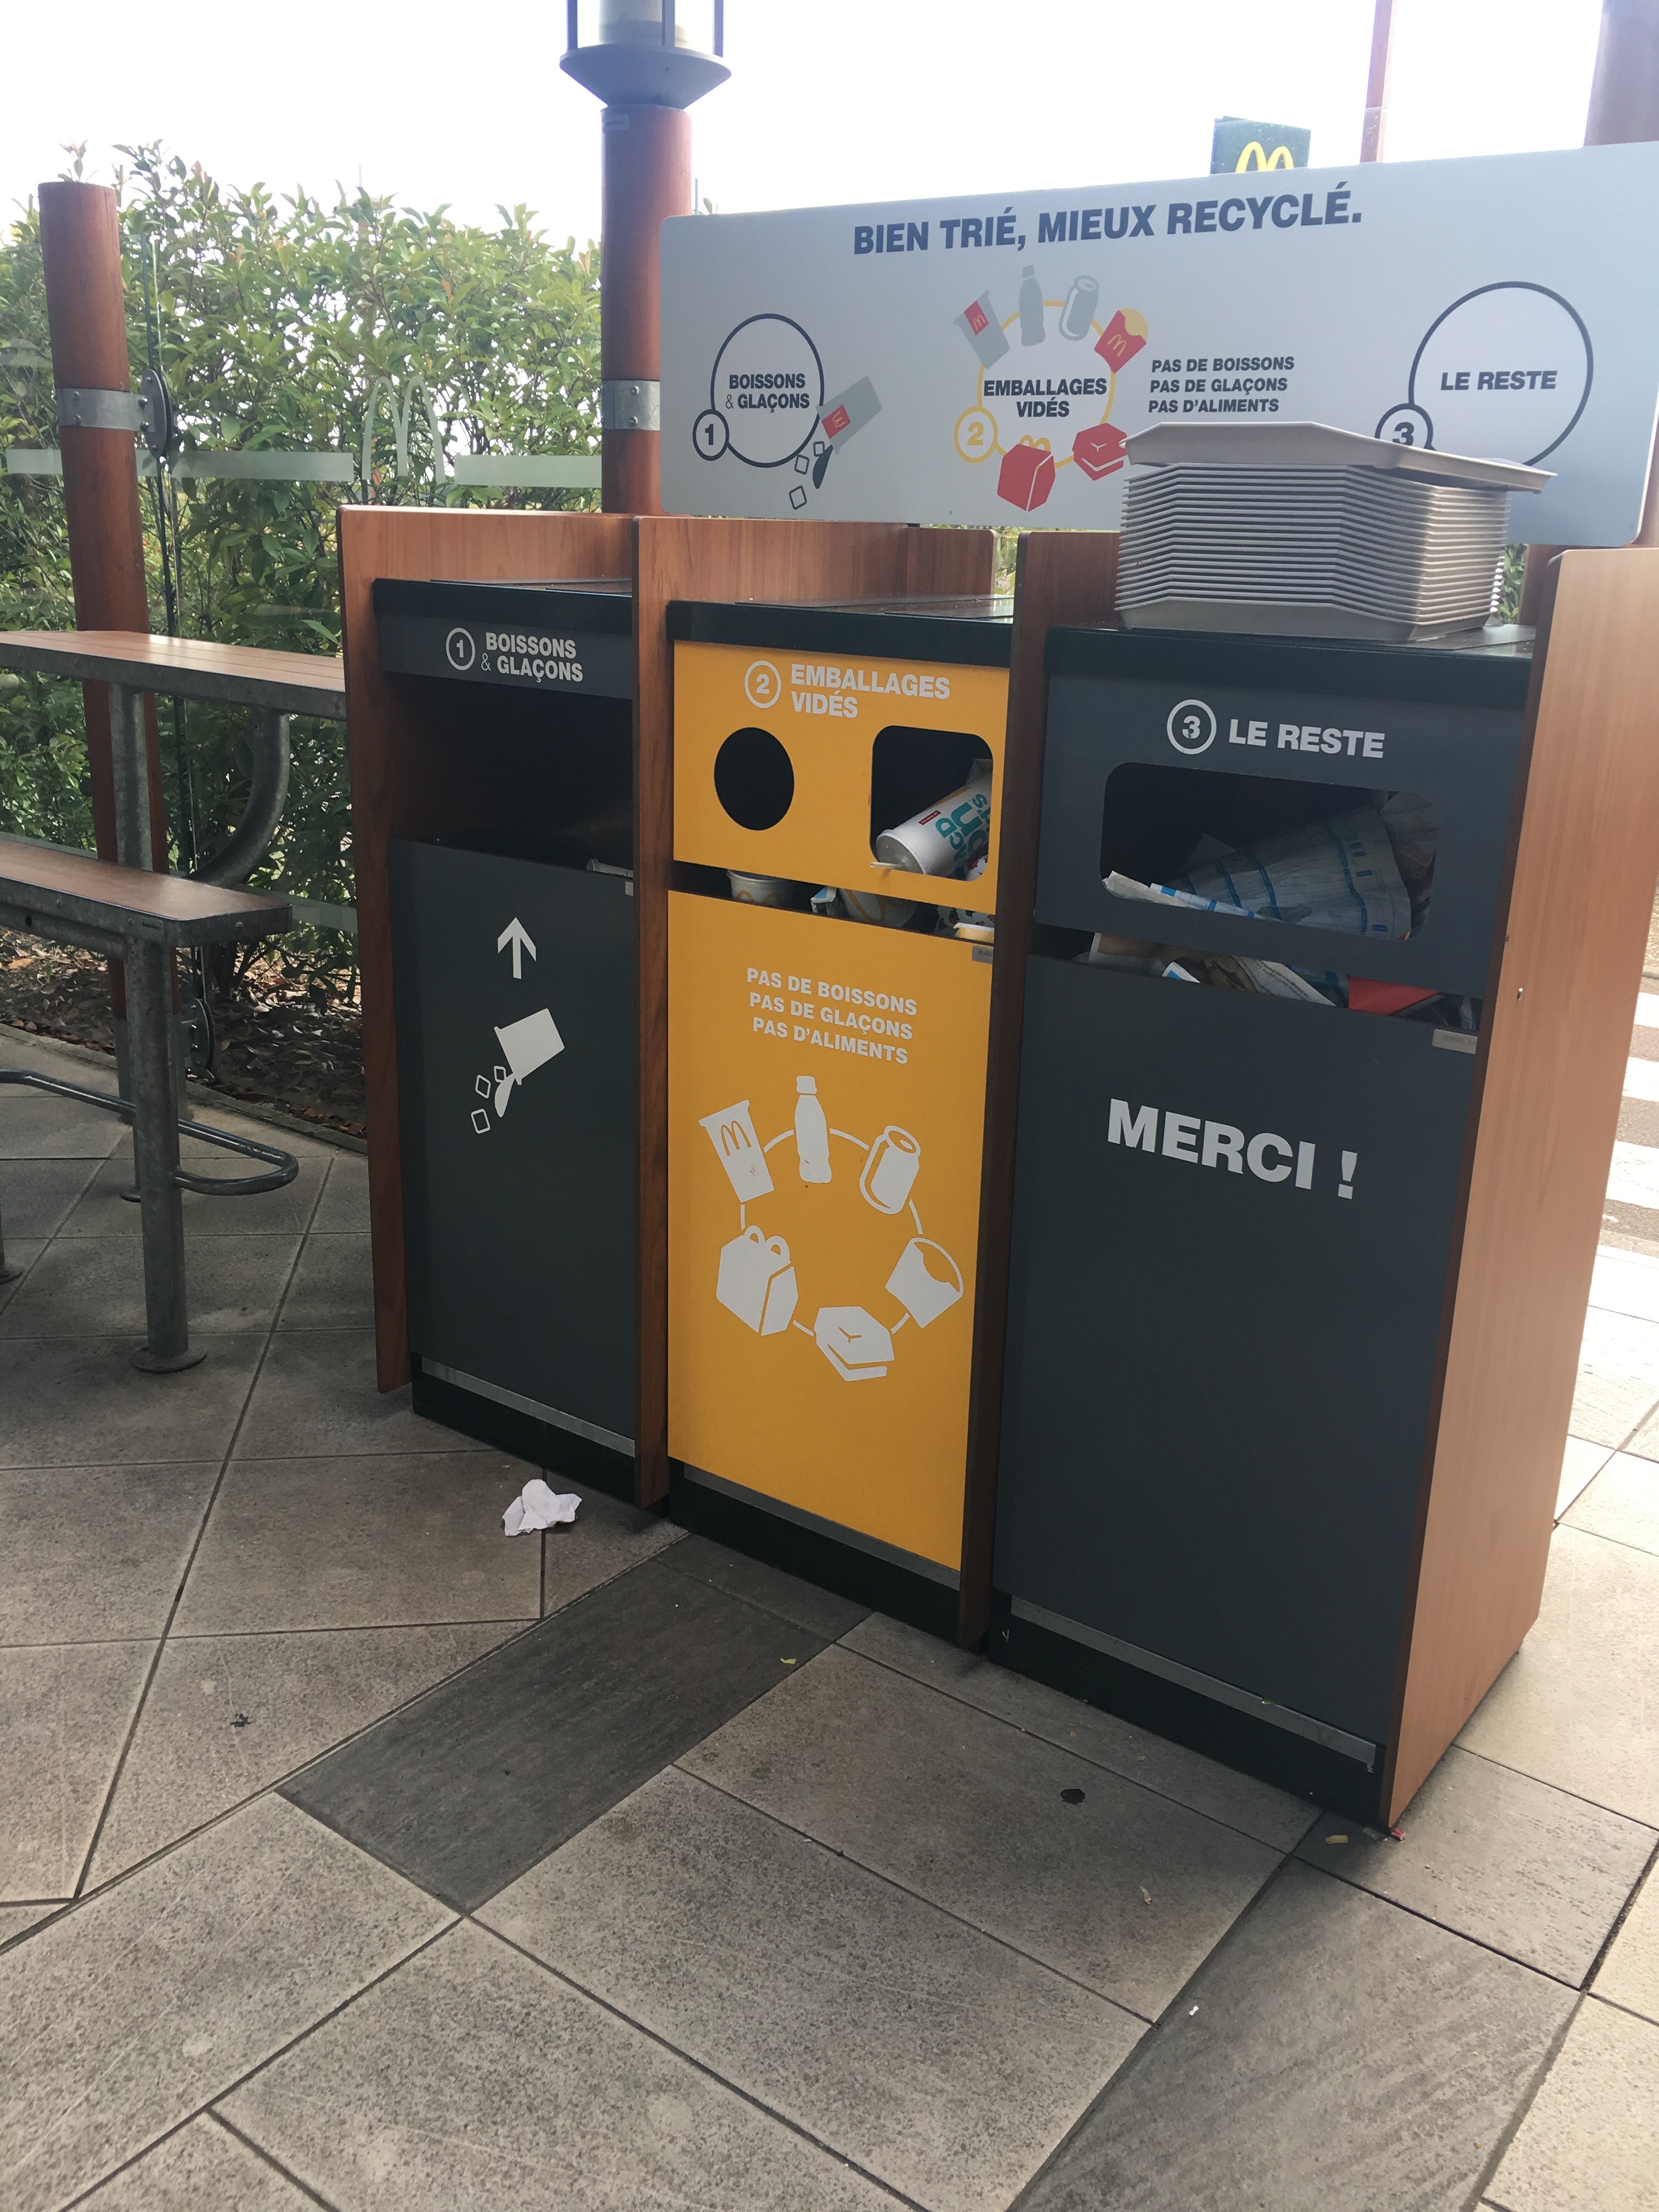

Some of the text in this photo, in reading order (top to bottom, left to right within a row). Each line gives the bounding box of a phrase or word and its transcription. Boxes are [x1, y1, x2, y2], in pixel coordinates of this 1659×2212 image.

[854, 182, 1361, 255] BIEN TRIÉ, MIEUX RECYCLÉ.
[1152, 357, 1294, 373] PAS DE BOISSONS
[730, 373, 805, 389] BOISSONS
[984, 378, 1107, 396] EMBALLAGES
[1150, 378, 1287, 395] PAS DE GLAÇONS
[1441, 371, 1557, 390] LE RESTE
[726, 393, 809, 413] & GLAÇONS
[1017, 397, 1069, 417] VIDÉS
[1149, 400, 1178, 413] PAS
[705, 424, 713, 445] 1
[967, 422, 984, 445] 2
[1392, 421, 1414, 446] 3
[456, 640, 464, 657] 1
[486, 633, 576, 658] BOISSONS
[481, 653, 583, 682] & GLAÇONS
[757, 674, 769, 694] 2
[792, 664, 950, 699] EMBALLAGES
[792, 691, 857, 718] VIDÉS
[1182, 716, 1385, 758] 3 LE RESTE
[748, 968, 917, 1015] PAS DE BOISSONS
[751, 992, 912, 1039] PAS DE GLAÇONS
[754, 1017, 787, 1037] PAS
[1108, 1098, 1357, 1199] MERCI !
